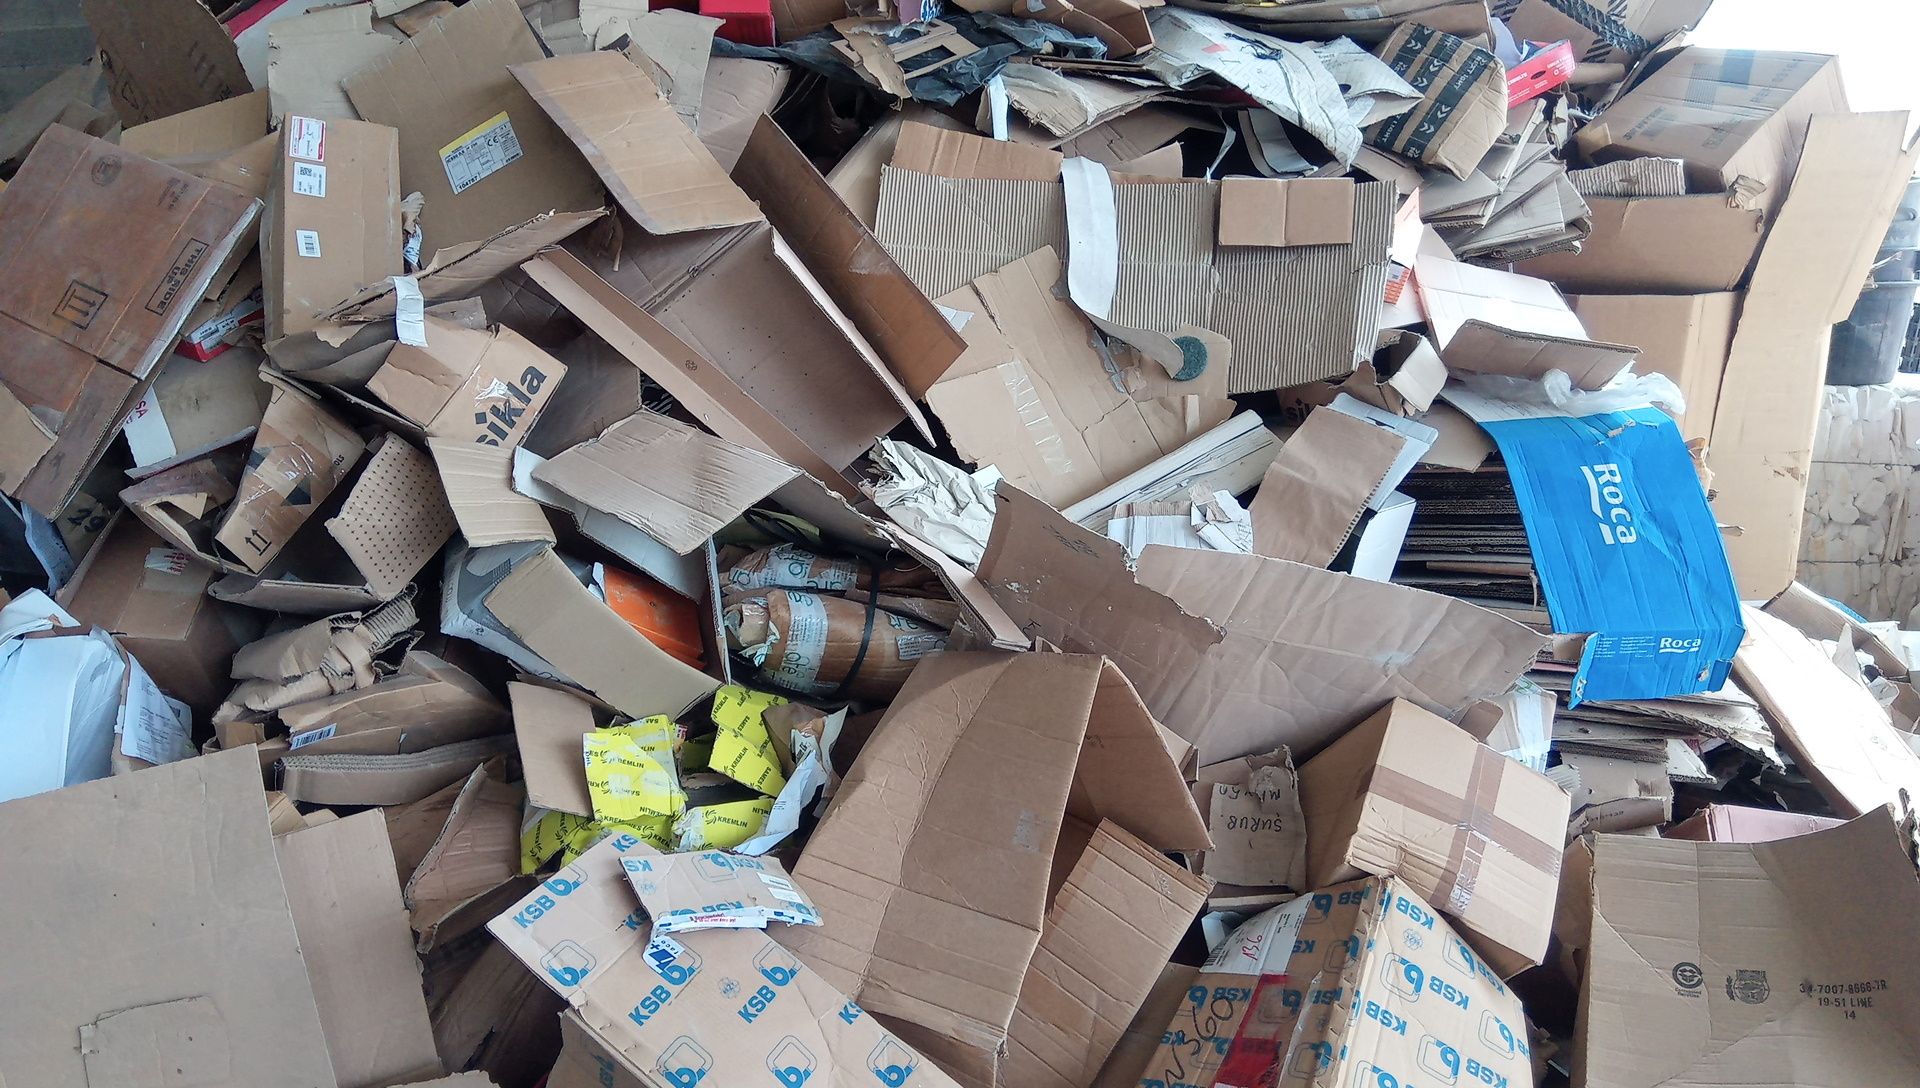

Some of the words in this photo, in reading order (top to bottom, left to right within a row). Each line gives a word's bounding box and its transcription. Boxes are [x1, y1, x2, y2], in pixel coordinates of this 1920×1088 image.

[166, 266, 181, 285] UP
[179, 247, 204, 277] THIS
[157, 278, 181, 311] SIDE
[1593, 463, 1637, 544] Roca
[1660, 637, 1702, 649] Roca
[731, 746, 749, 769] KREMLIN
[758, 766, 772, 785] SAMES
[717, 816, 748, 828] KREMLIN
[512, 894, 557, 929] KSB
[1396, 896, 1435, 931] KSB
[1213, 986, 1252, 1003] KSB
[1429, 975, 1470, 1011] KSB
[1477, 961, 1506, 997] KSB
[628, 984, 672, 1027] KSB
[737, 984, 778, 1025] KSB
[1365, 1000, 1408, 1036] KSB
[1843, 1009, 1857, 1020] 14
[1465, 1058, 1508, 1088] KSB
